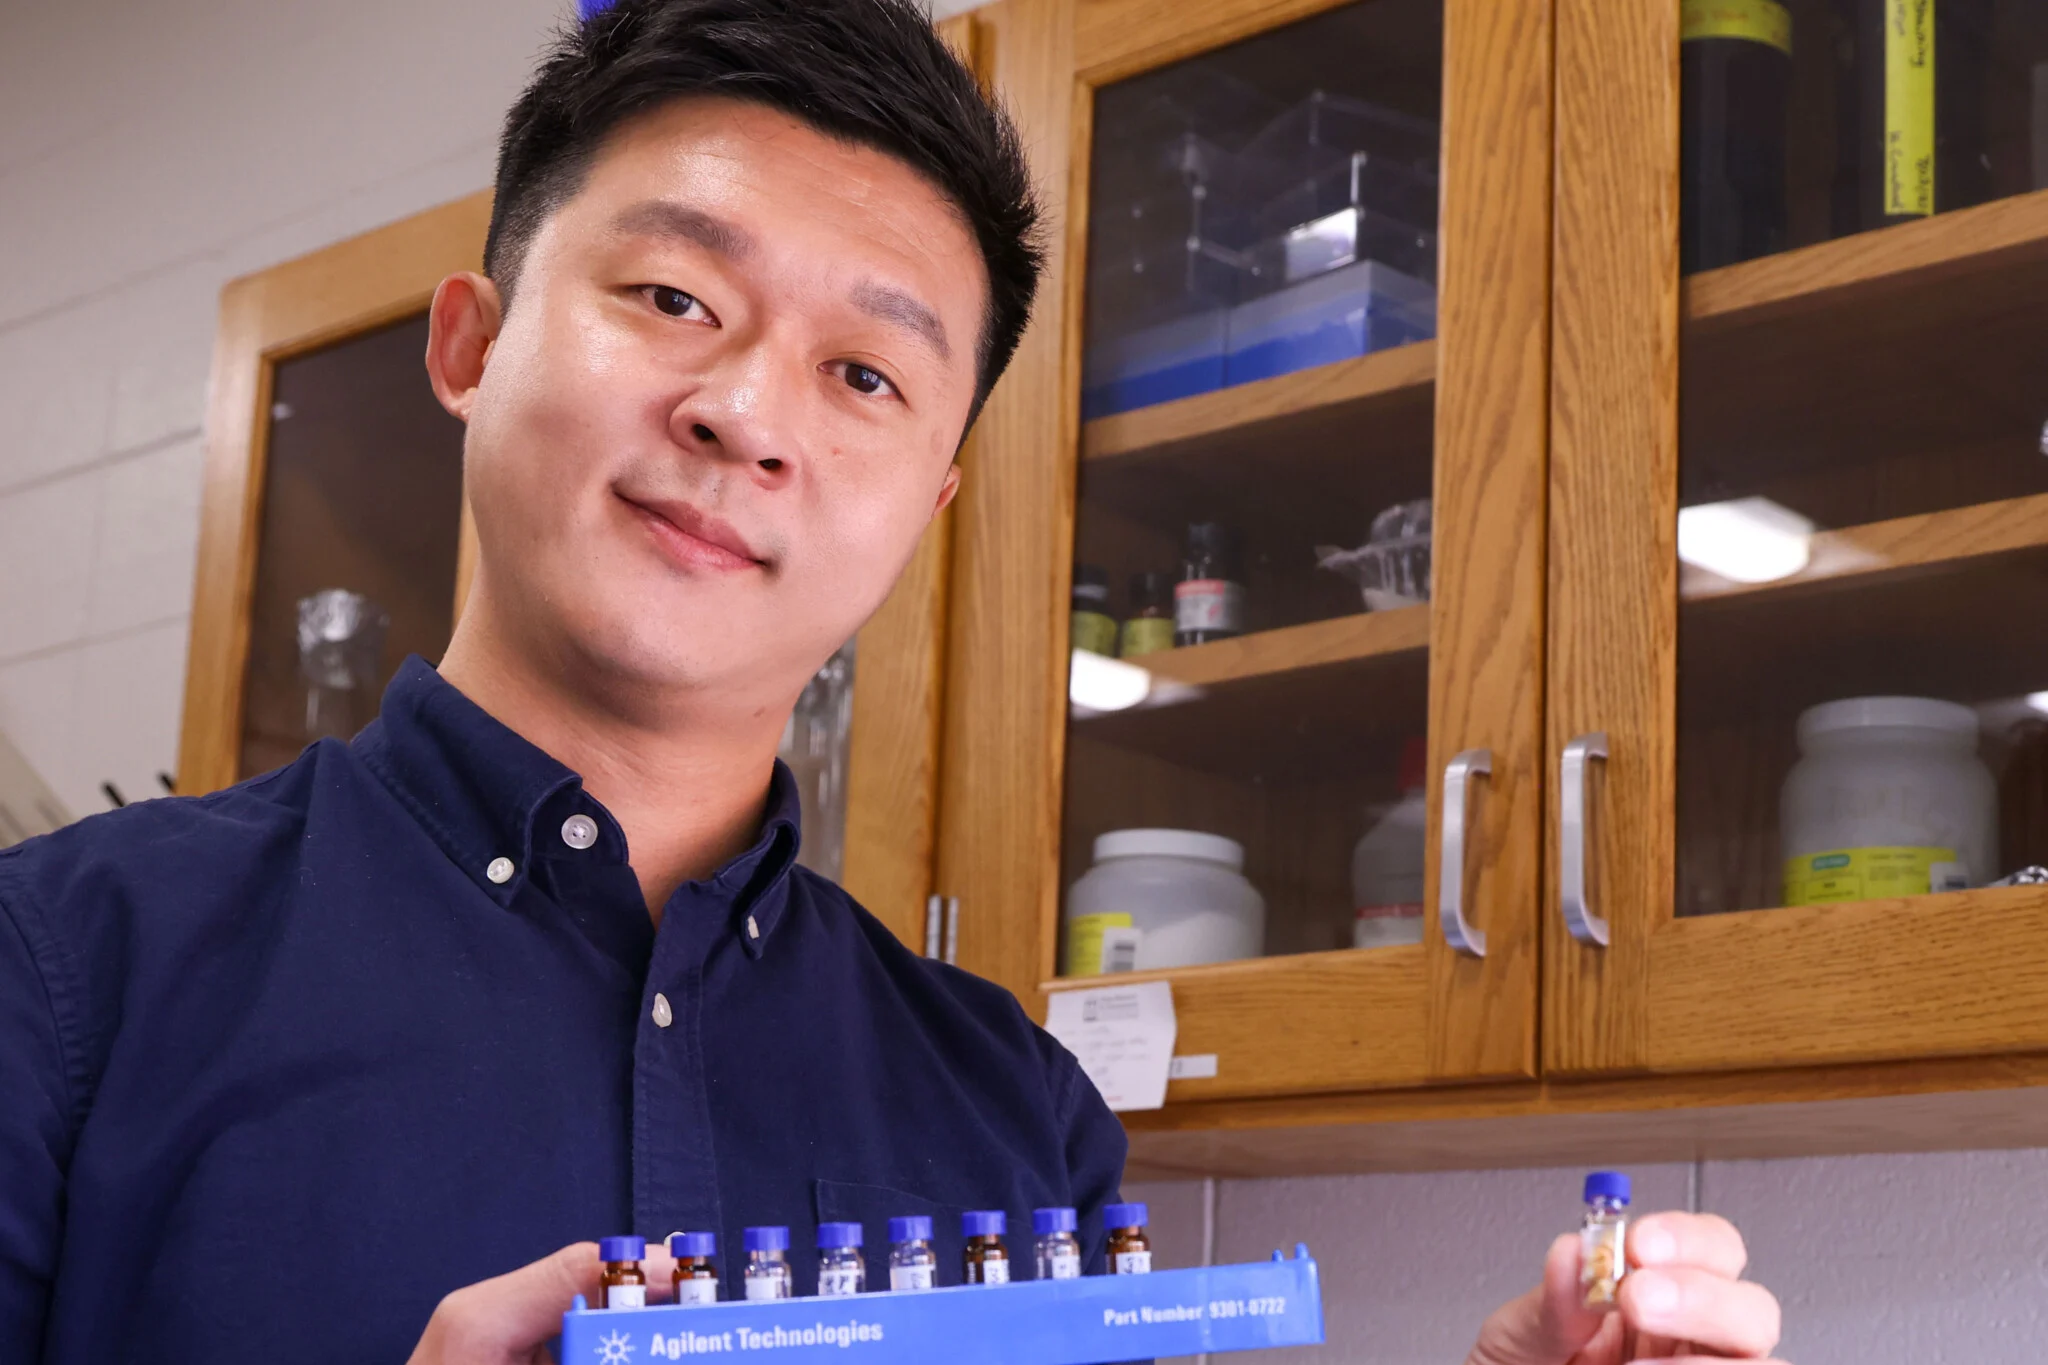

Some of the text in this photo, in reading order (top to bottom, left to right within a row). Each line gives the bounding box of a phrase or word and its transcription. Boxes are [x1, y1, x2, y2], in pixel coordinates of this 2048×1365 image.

[1103, 1297, 1285, 1327] Part Number 9301-0722
[650, 1320, 883, 1359] Agilent Technologies
